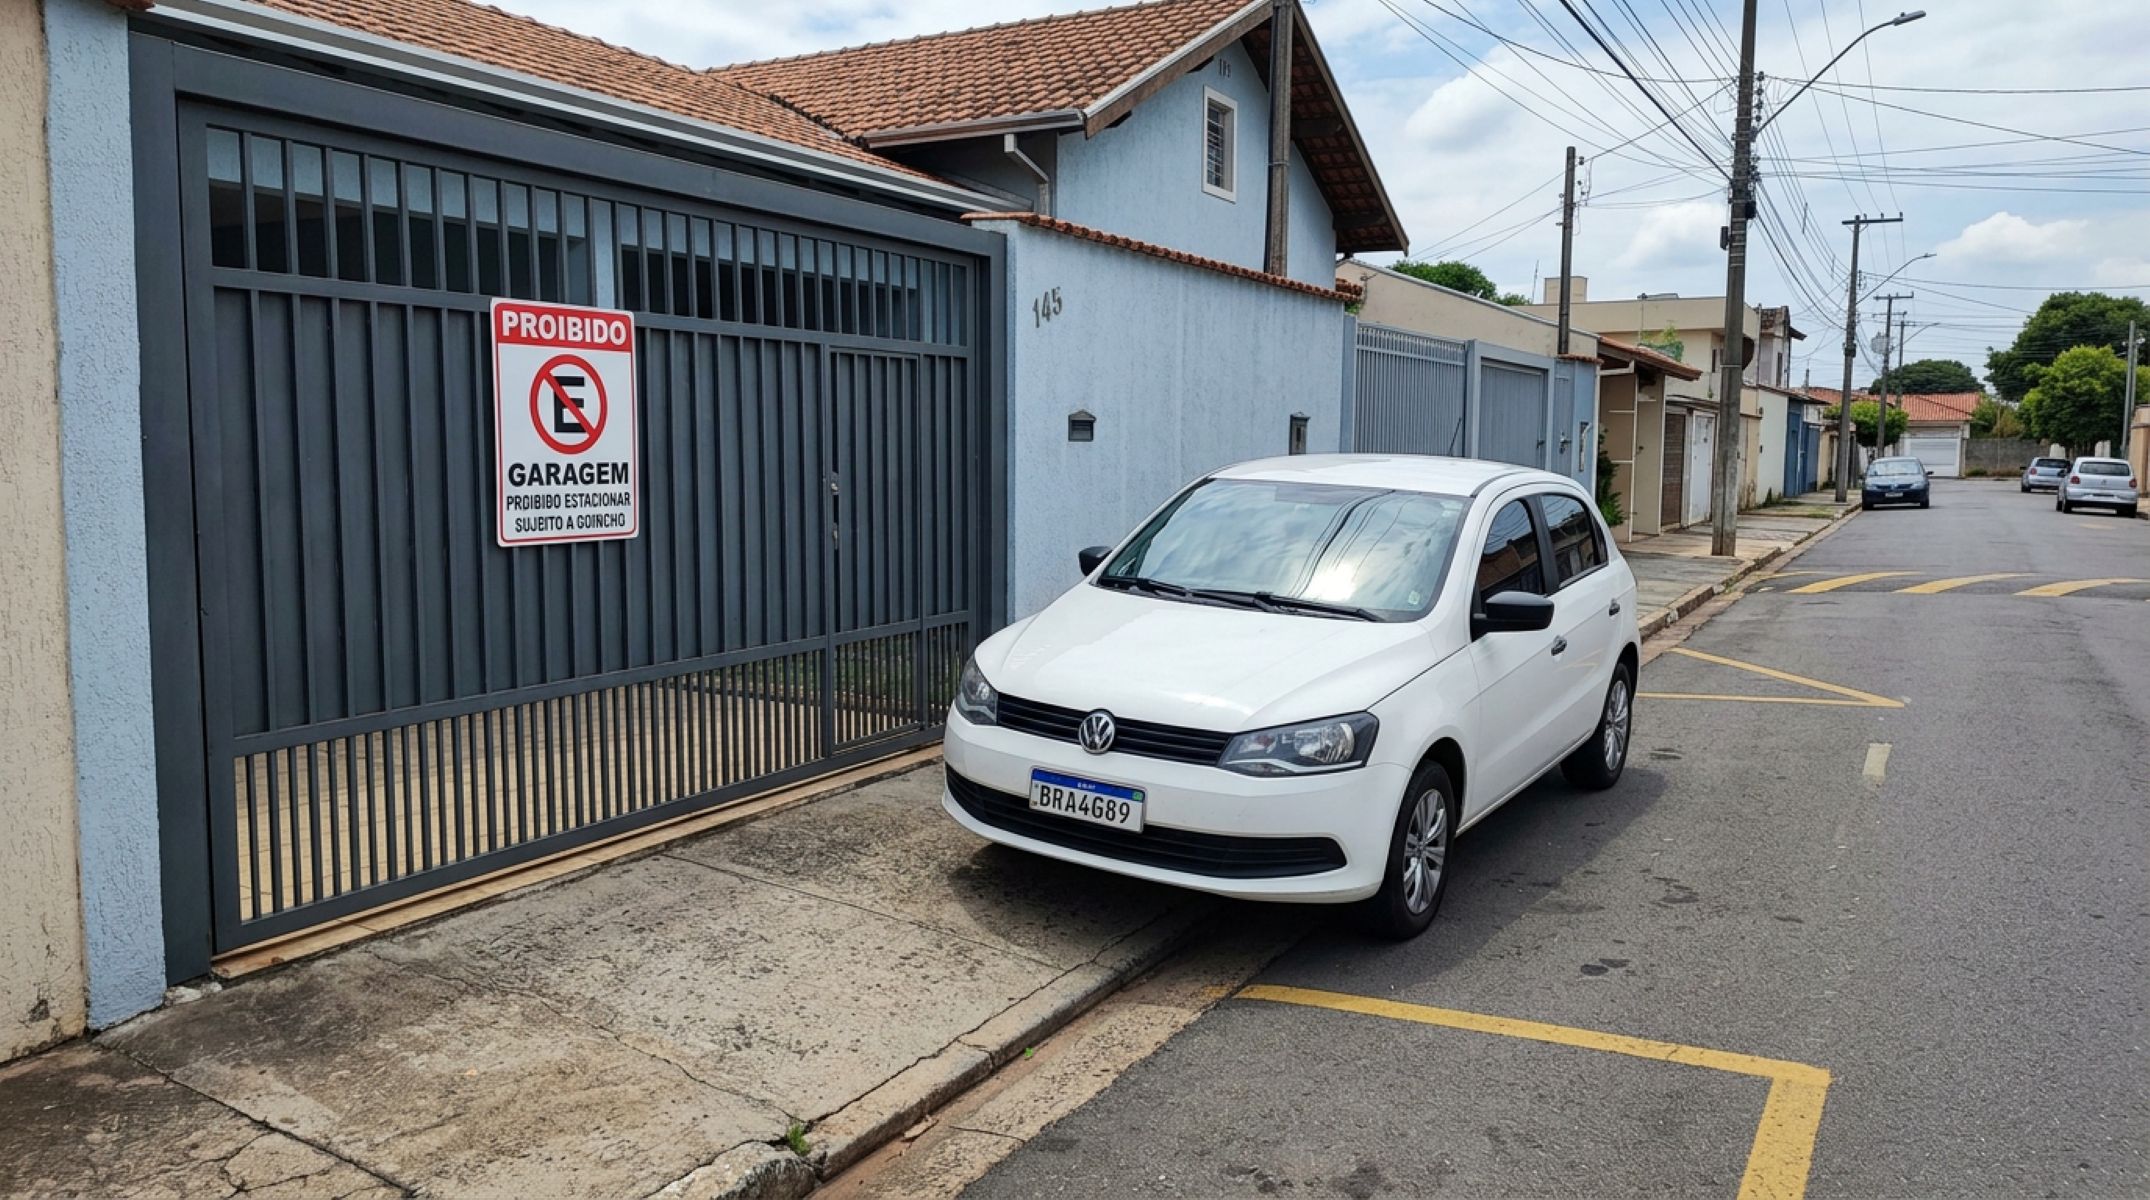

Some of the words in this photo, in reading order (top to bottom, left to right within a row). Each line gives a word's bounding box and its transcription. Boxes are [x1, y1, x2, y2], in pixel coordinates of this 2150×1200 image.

[1031, 286, 1062, 328] 145
[502, 310, 627, 346] PROIBIDO
[554, 376, 588, 433] E
[508, 462, 629, 487] GARAGEM
[506, 494, 561, 511] PROIBIDO
[564, 492, 631, 509] ESTACIONAR
[515, 515, 563, 533] SUJEITO
[566, 515, 574, 530] A
[1040, 784, 1130, 824] BRA4G89
